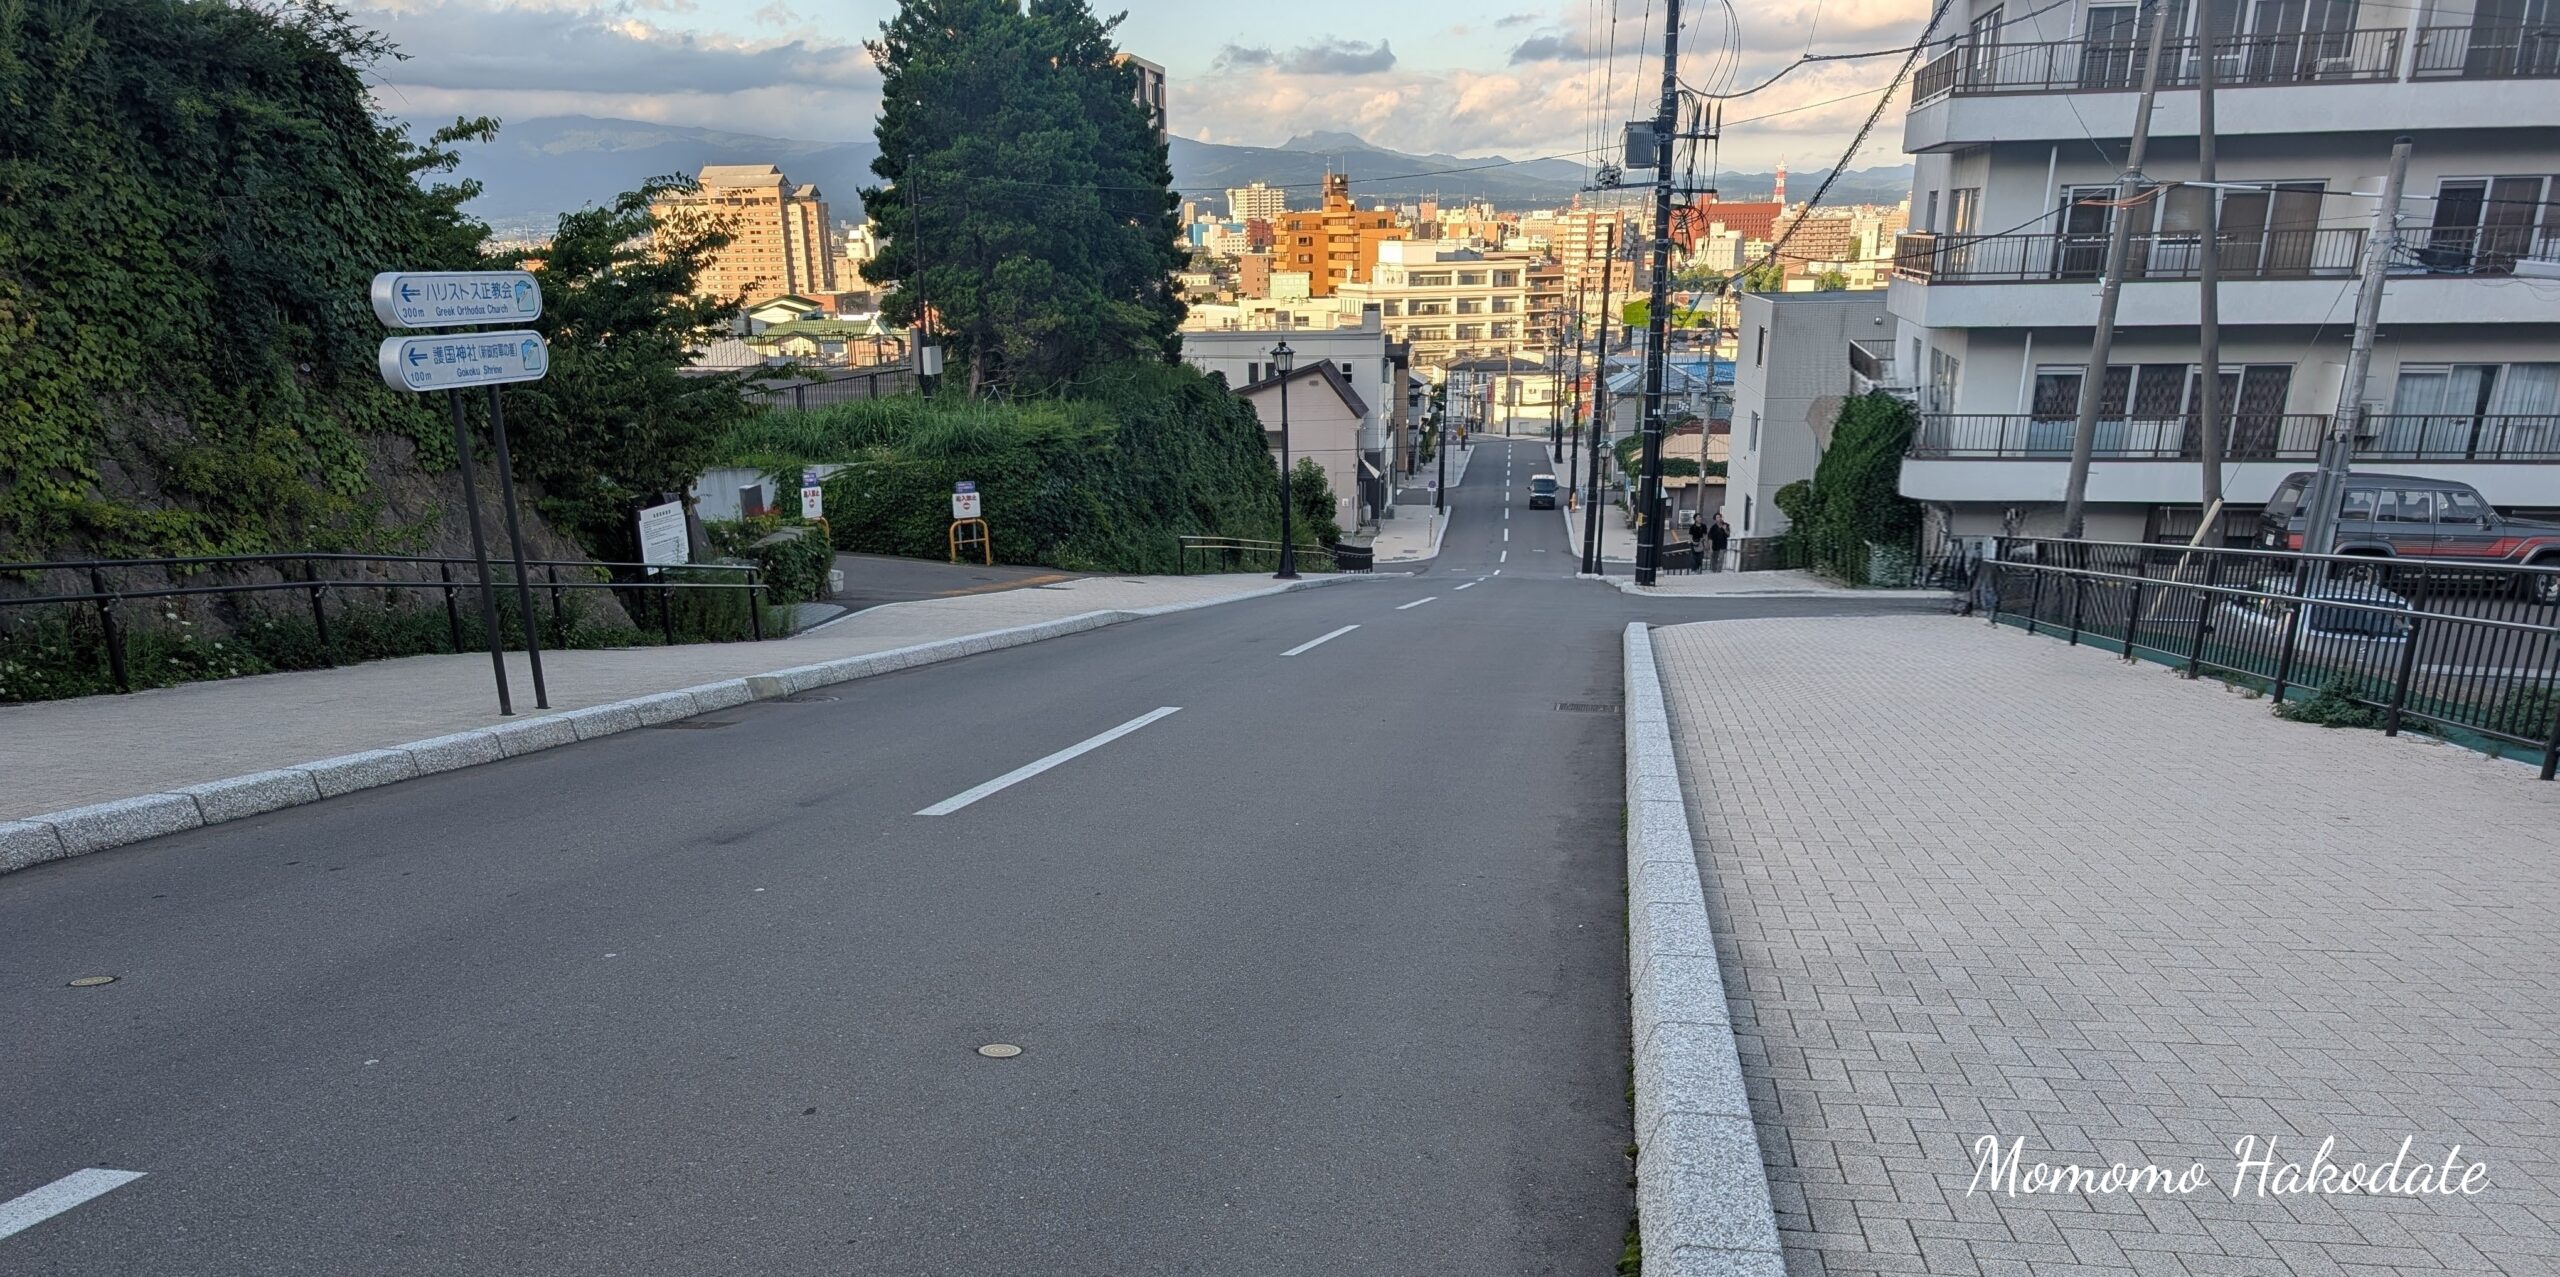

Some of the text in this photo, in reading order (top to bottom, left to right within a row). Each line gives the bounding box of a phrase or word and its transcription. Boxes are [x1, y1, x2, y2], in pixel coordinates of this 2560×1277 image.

[426, 281, 513, 301] ハリストス正教会
[402, 307, 425, 318] 300m
[435, 303, 509, 317] Greek Orthodox Church
[410, 371, 433, 382] 100m
[456, 364, 503, 378] Gokoku Shrine
